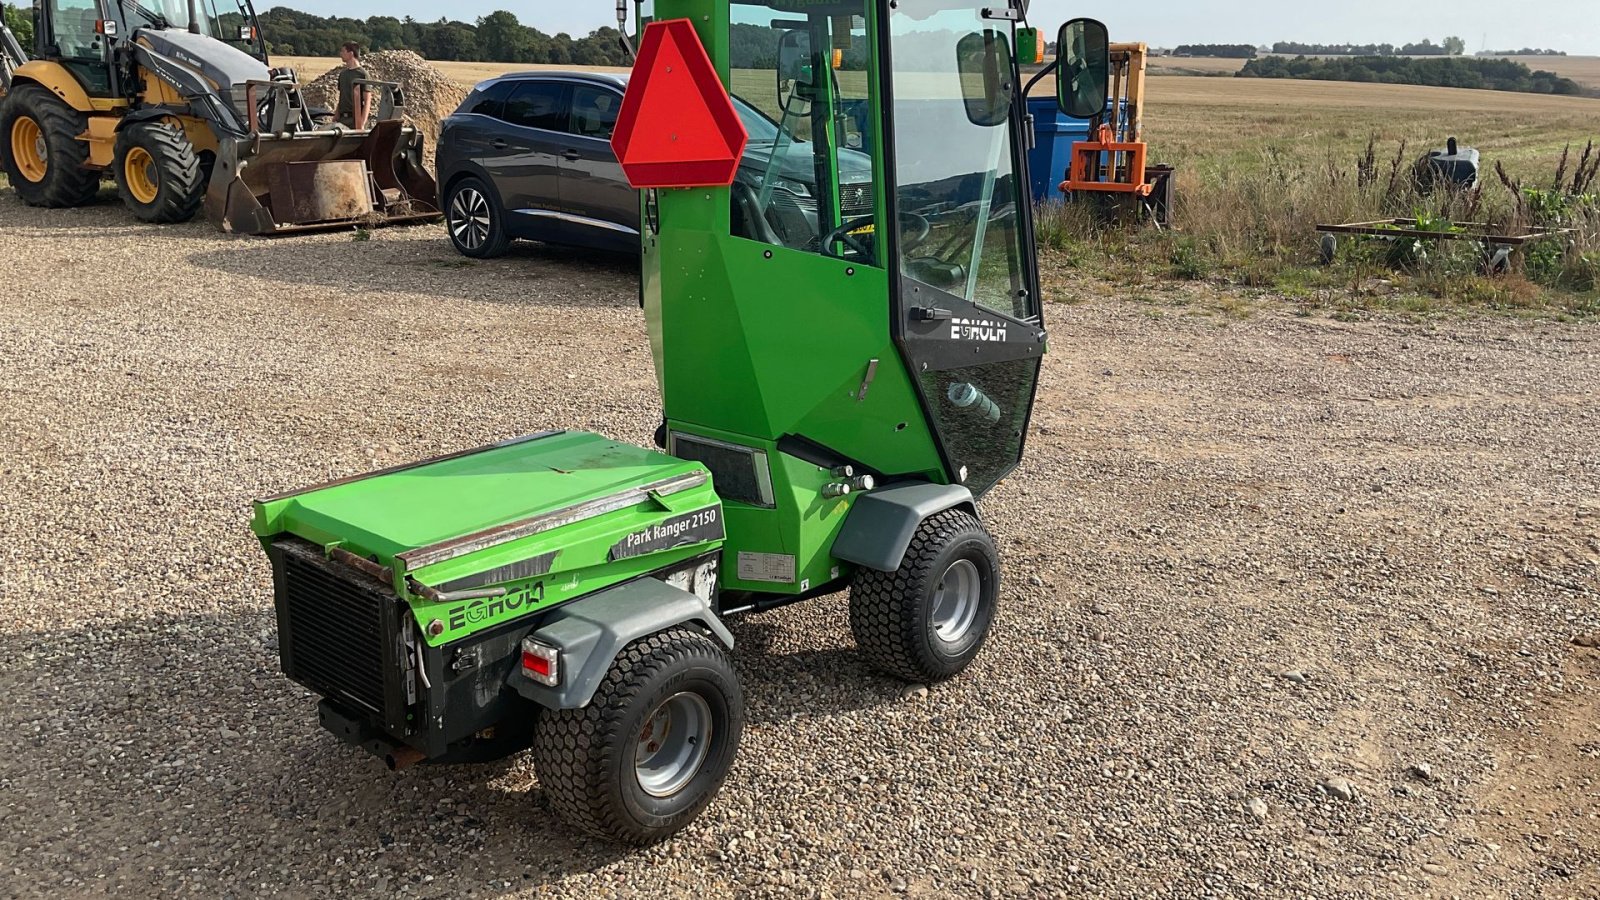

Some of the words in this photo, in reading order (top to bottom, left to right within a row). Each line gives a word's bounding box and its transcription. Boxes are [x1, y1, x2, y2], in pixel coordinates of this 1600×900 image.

[951, 317, 1007, 342] EGHOLM
[627, 528, 652, 547] Park
[653, 518, 691, 540] Ranger
[691, 509, 716, 528] 2150
